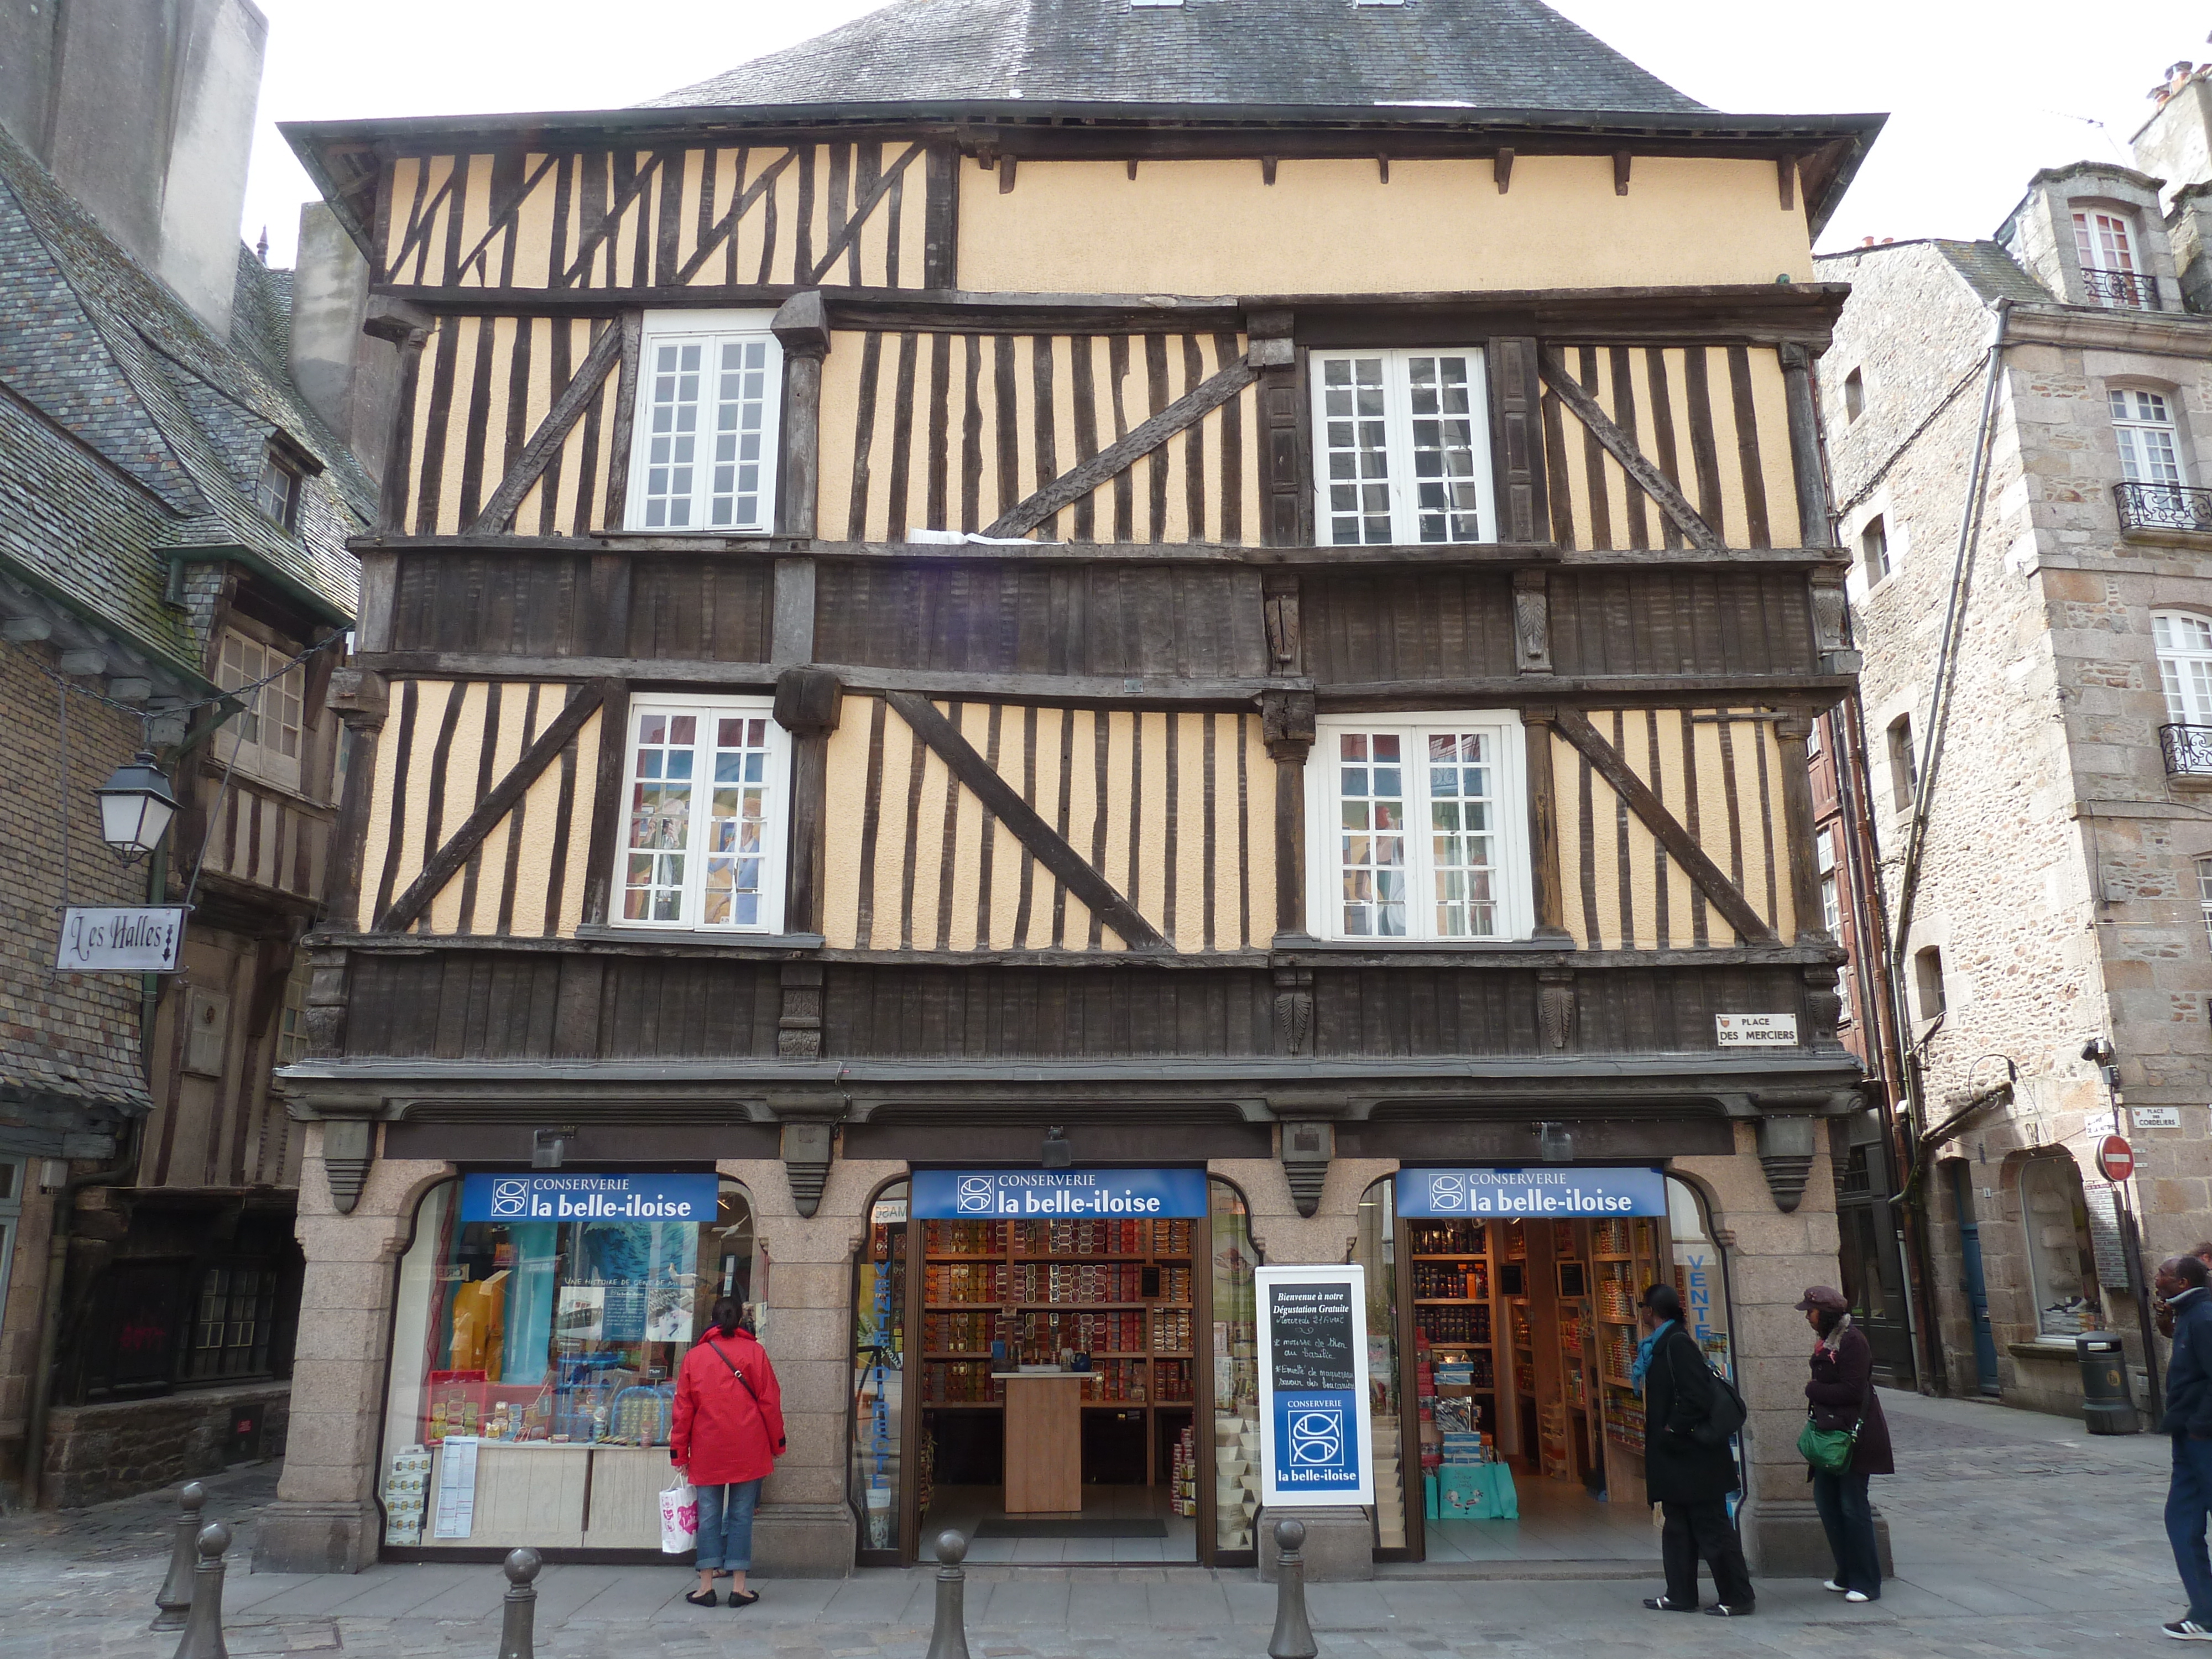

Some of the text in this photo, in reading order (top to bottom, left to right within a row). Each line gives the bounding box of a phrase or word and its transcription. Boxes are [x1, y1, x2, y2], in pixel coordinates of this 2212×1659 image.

[70, 915, 162, 961] Les Halles
[1720, 1031, 1795, 1040] DES MERCIERS
[533, 1178, 629, 1190] CONSERVERIE
[998, 1175, 1095, 1186] CONSERVERIE
[1469, 1173, 1566, 1185] CONSERVERIE
[531, 1193, 691, 1217] la belle-iloise
[998, 1190, 1160, 1213] la belle-iloise
[1470, 1188, 1631, 1211] la belle-iloise
[565, 1277, 582, 1285] UNE
[1277, 1292, 1316, 1301] Bienvenue
[1317, 1292, 1323, 1300] à
[1687, 1255, 1710, 1340] VENTE
[873, 1261, 890, 1347] VENTE
[1273, 1304, 1349, 1316] Dégustation Gratuite
[1314, 1338, 1325, 1347] de
[1308, 1367, 1317, 1376] de
[1307, 1378, 1318, 1386] des
[871, 1364, 890, 1489] DIRECTE
[1278, 1469, 1357, 1481] la belle-iloise
